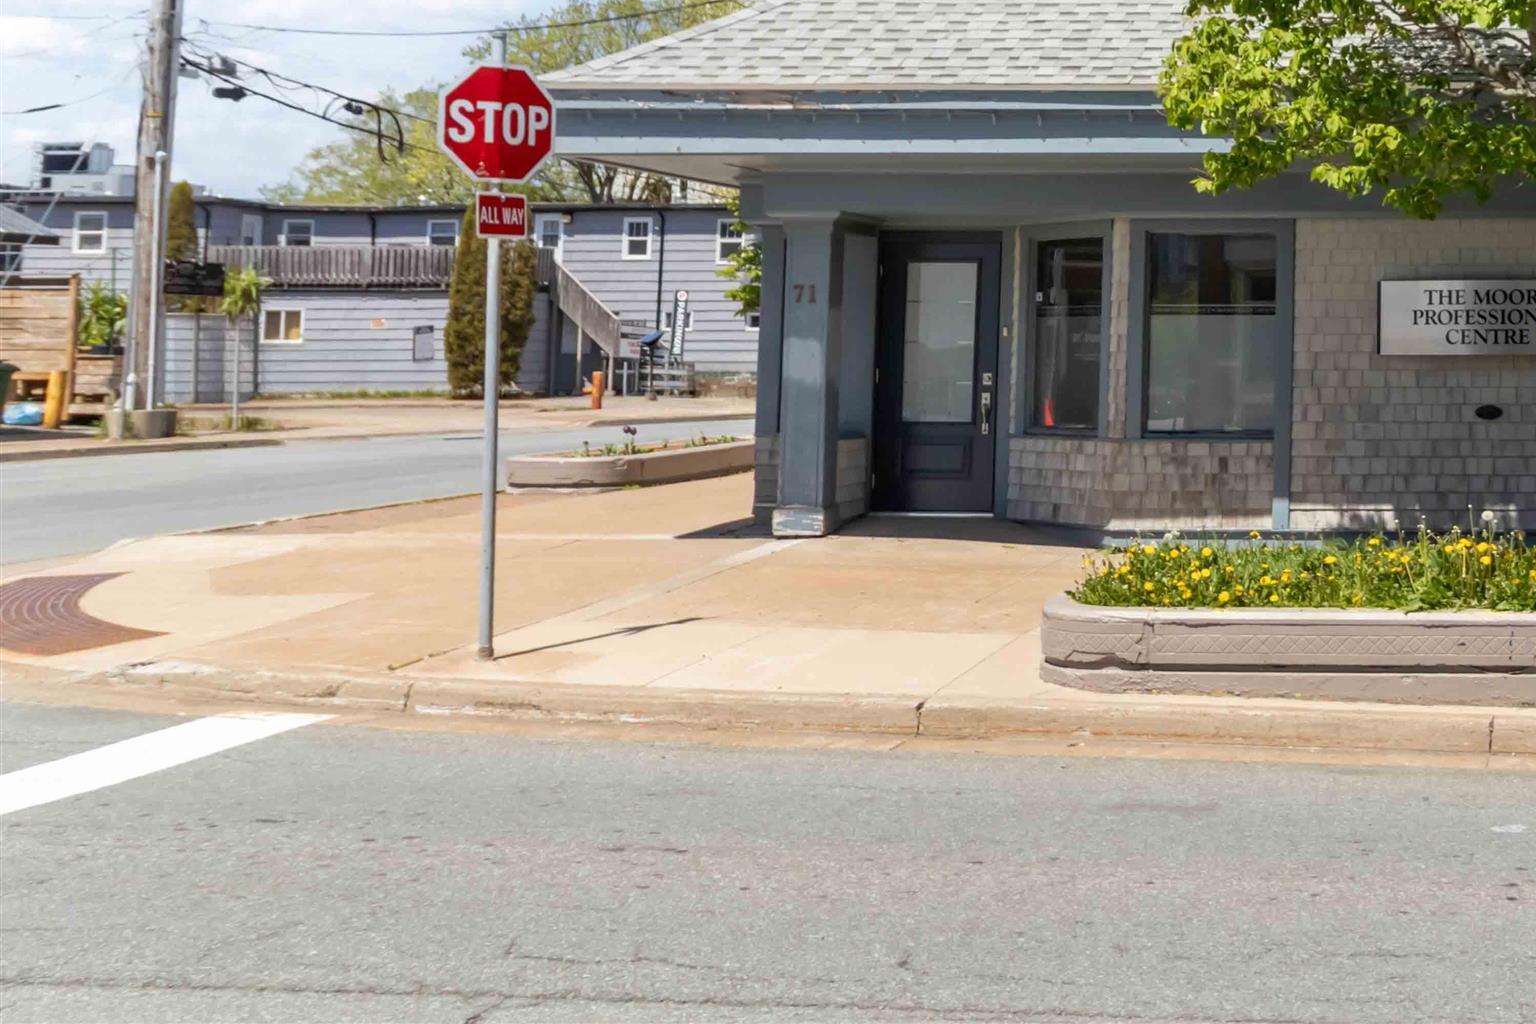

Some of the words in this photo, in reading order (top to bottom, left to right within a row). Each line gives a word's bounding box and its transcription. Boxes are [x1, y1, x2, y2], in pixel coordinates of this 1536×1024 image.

[448, 98, 550, 147] STOP
[480, 205, 500, 225] ALL
[502, 207, 525, 226] WAY
[792, 283, 817, 305] 71
[1423, 289, 1467, 306] THE
[1445, 328, 1531, 345] CENTRE
